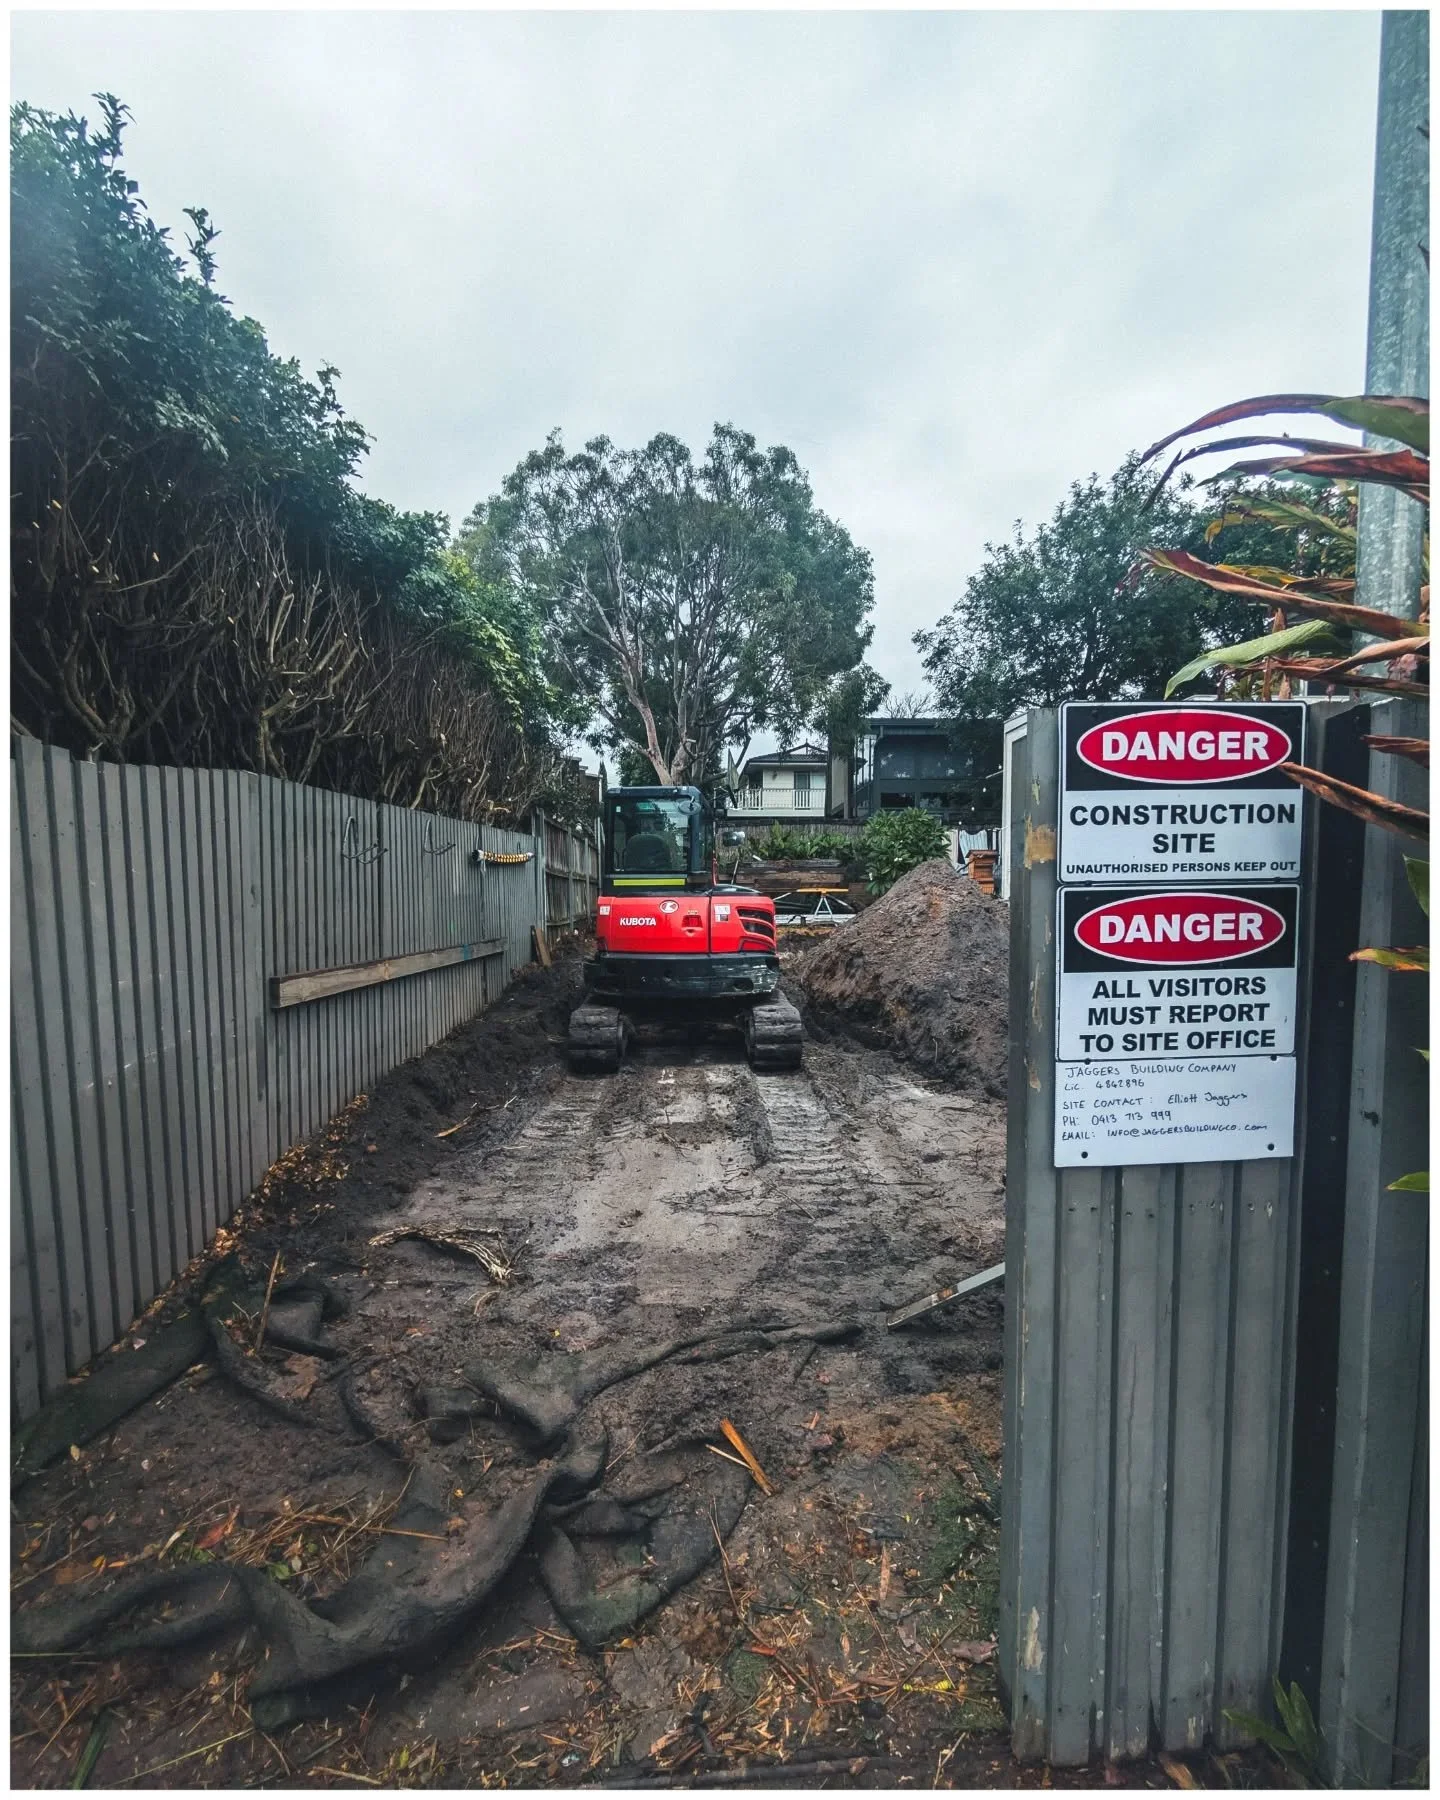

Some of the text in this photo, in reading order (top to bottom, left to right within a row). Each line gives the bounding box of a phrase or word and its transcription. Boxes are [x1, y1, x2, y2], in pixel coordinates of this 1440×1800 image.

[1102, 731, 1270, 761] DANGER
[1069, 803, 1296, 826] CONSTRUCTION
[1152, 833, 1216, 854] SITE
[1066, 861, 1297, 874] UNAUTHORISED PERSONS KEEP OUT
[619, 917, 657, 926] KUBOTA
[1099, 912, 1264, 944] DANGER
[1092, 976, 1266, 999] ALL VISITORS
[1088, 1003, 1270, 1026] MUST REPORT
[1079, 1029, 1276, 1052] TO SITE OFFICE
[1065, 1063, 1236, 1078] JAGGERS BUILDING COMPANY
[1063, 1100, 1085, 1110] SITE
[1168, 1093, 1197, 1104] Elliott
[1091, 1114, 1117, 1126] 0413
[1124, 1111, 1143, 1121] 713
[1150, 1110, 1172, 1121] 999
[1062, 1131, 1096, 1141] EMAIL:
